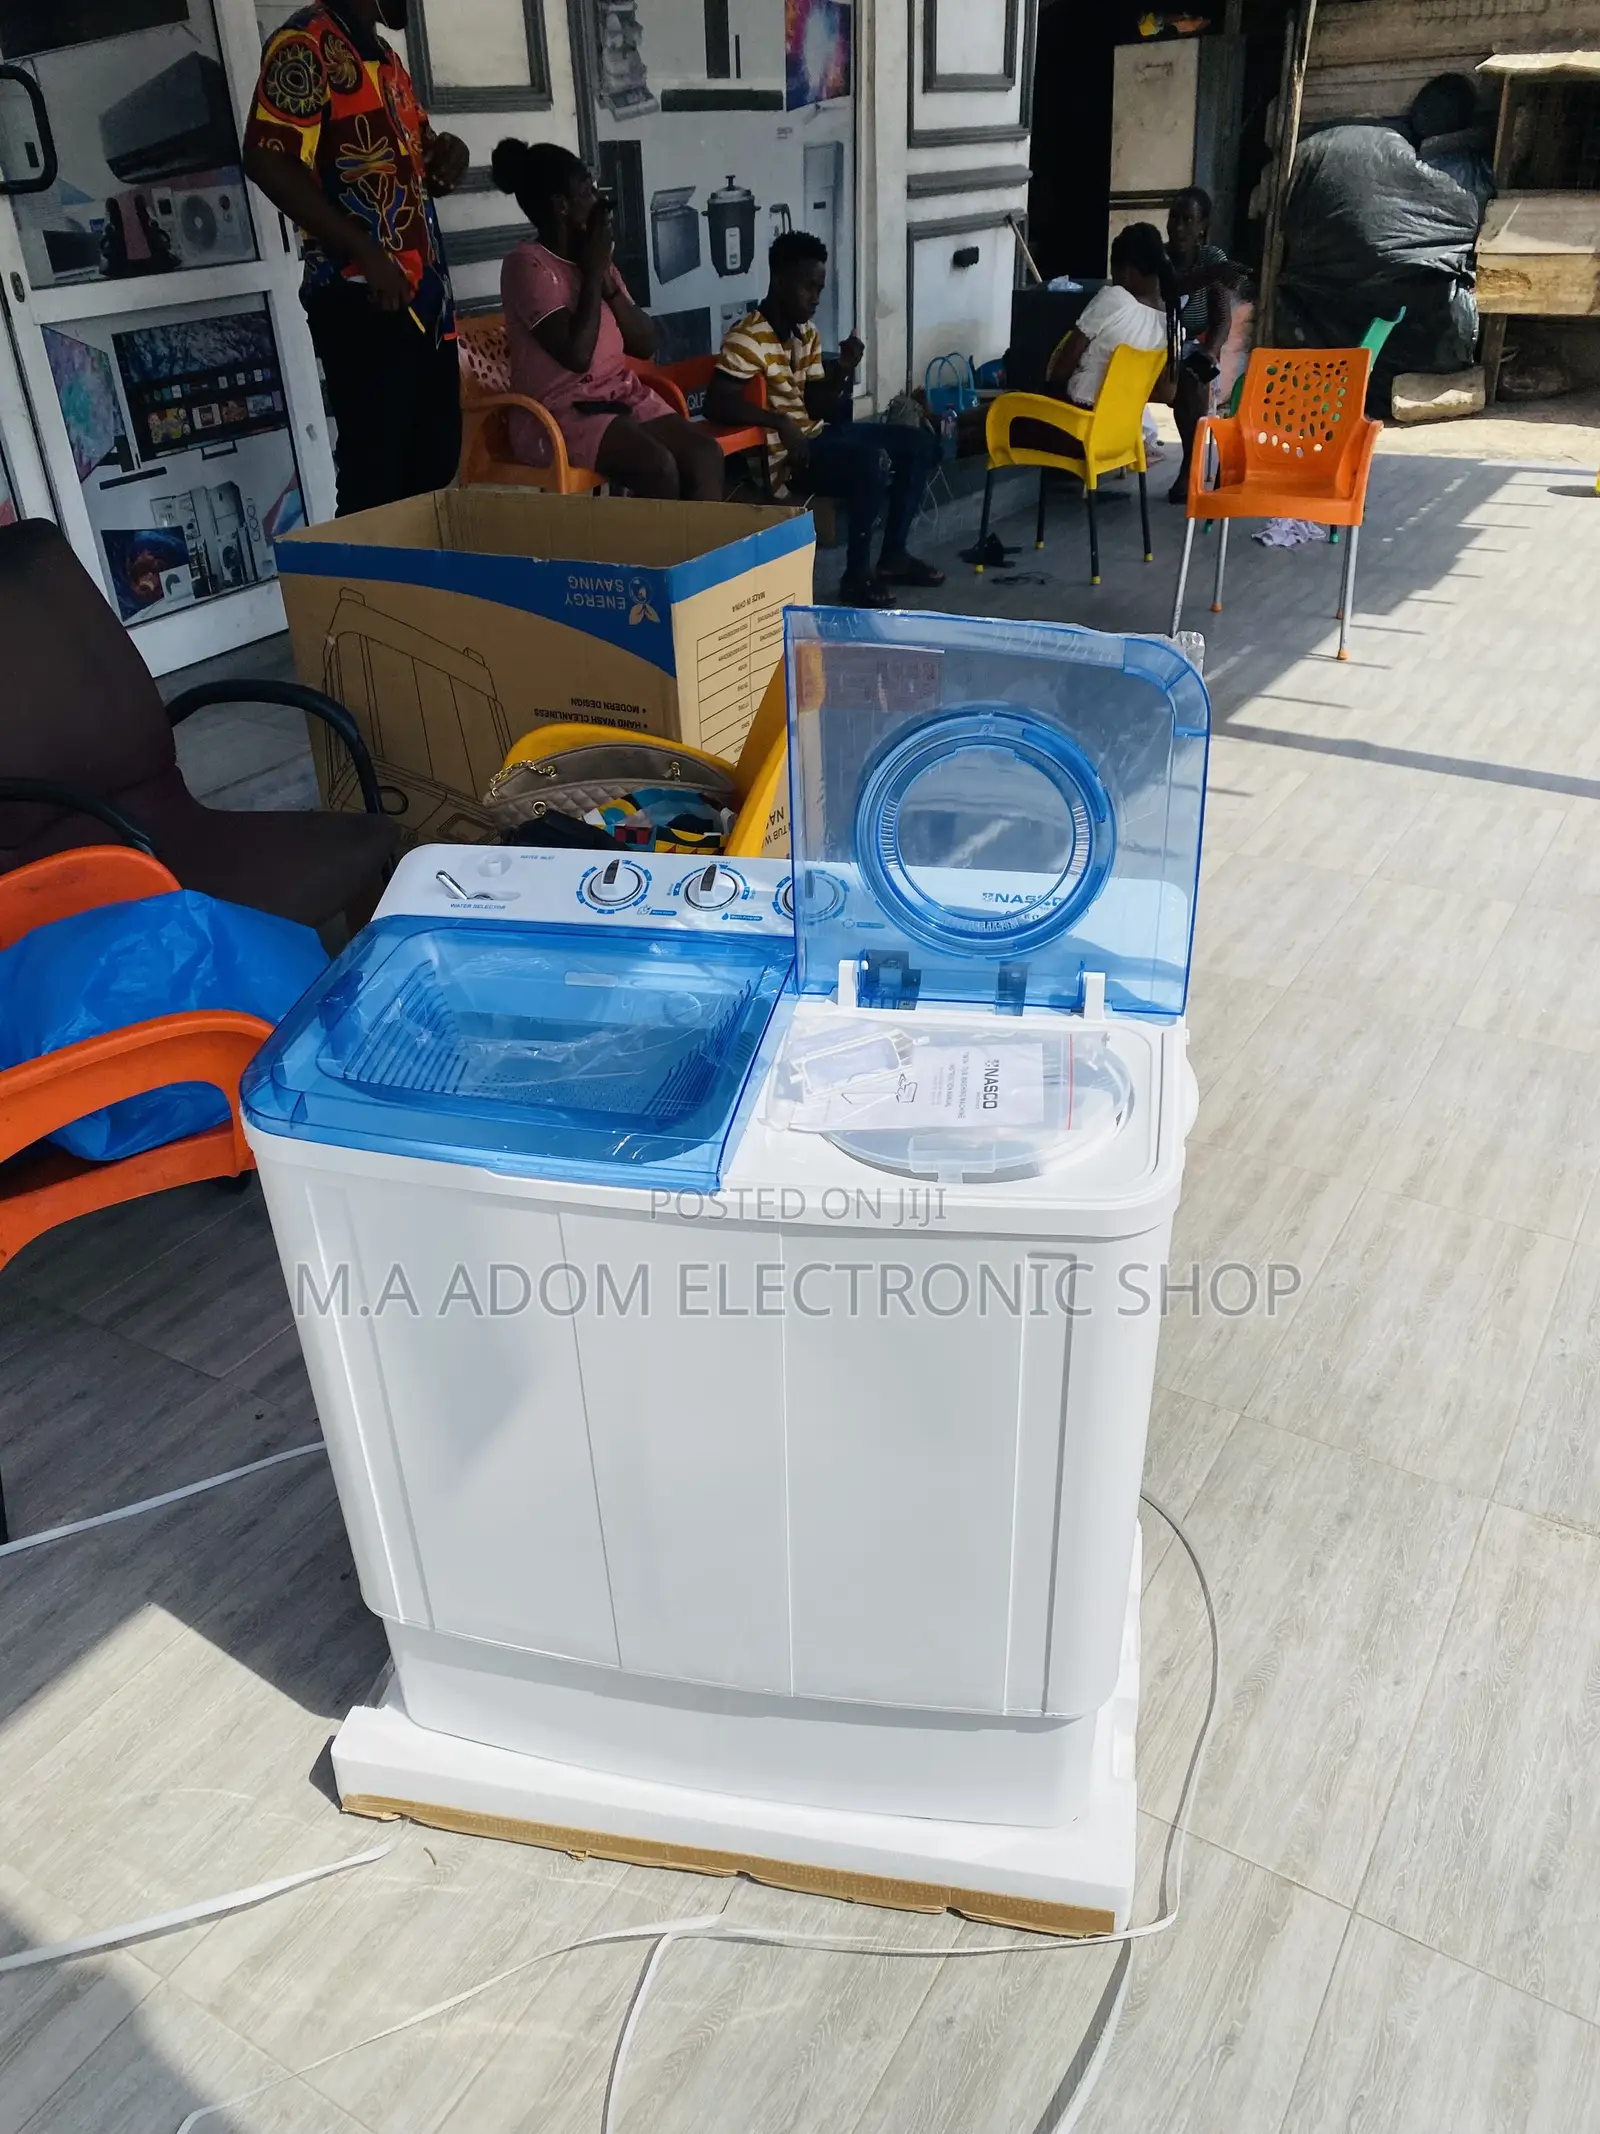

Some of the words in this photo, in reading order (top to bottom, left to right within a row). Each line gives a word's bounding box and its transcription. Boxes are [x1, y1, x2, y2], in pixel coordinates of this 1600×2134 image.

[568, 576, 624, 593] SAVING
[565, 593, 626, 610] ENERGY
[571, 698, 602, 709] DESIGN
[604, 700, 640, 714] MODERN
[534, 708, 589, 722] CLEANLINESS
[591, 714, 616, 728] WASH
[618, 719, 641, 729] HAND
[773, 824, 788, 840] TUB
[982, 1068, 999, 1109] NASCO
